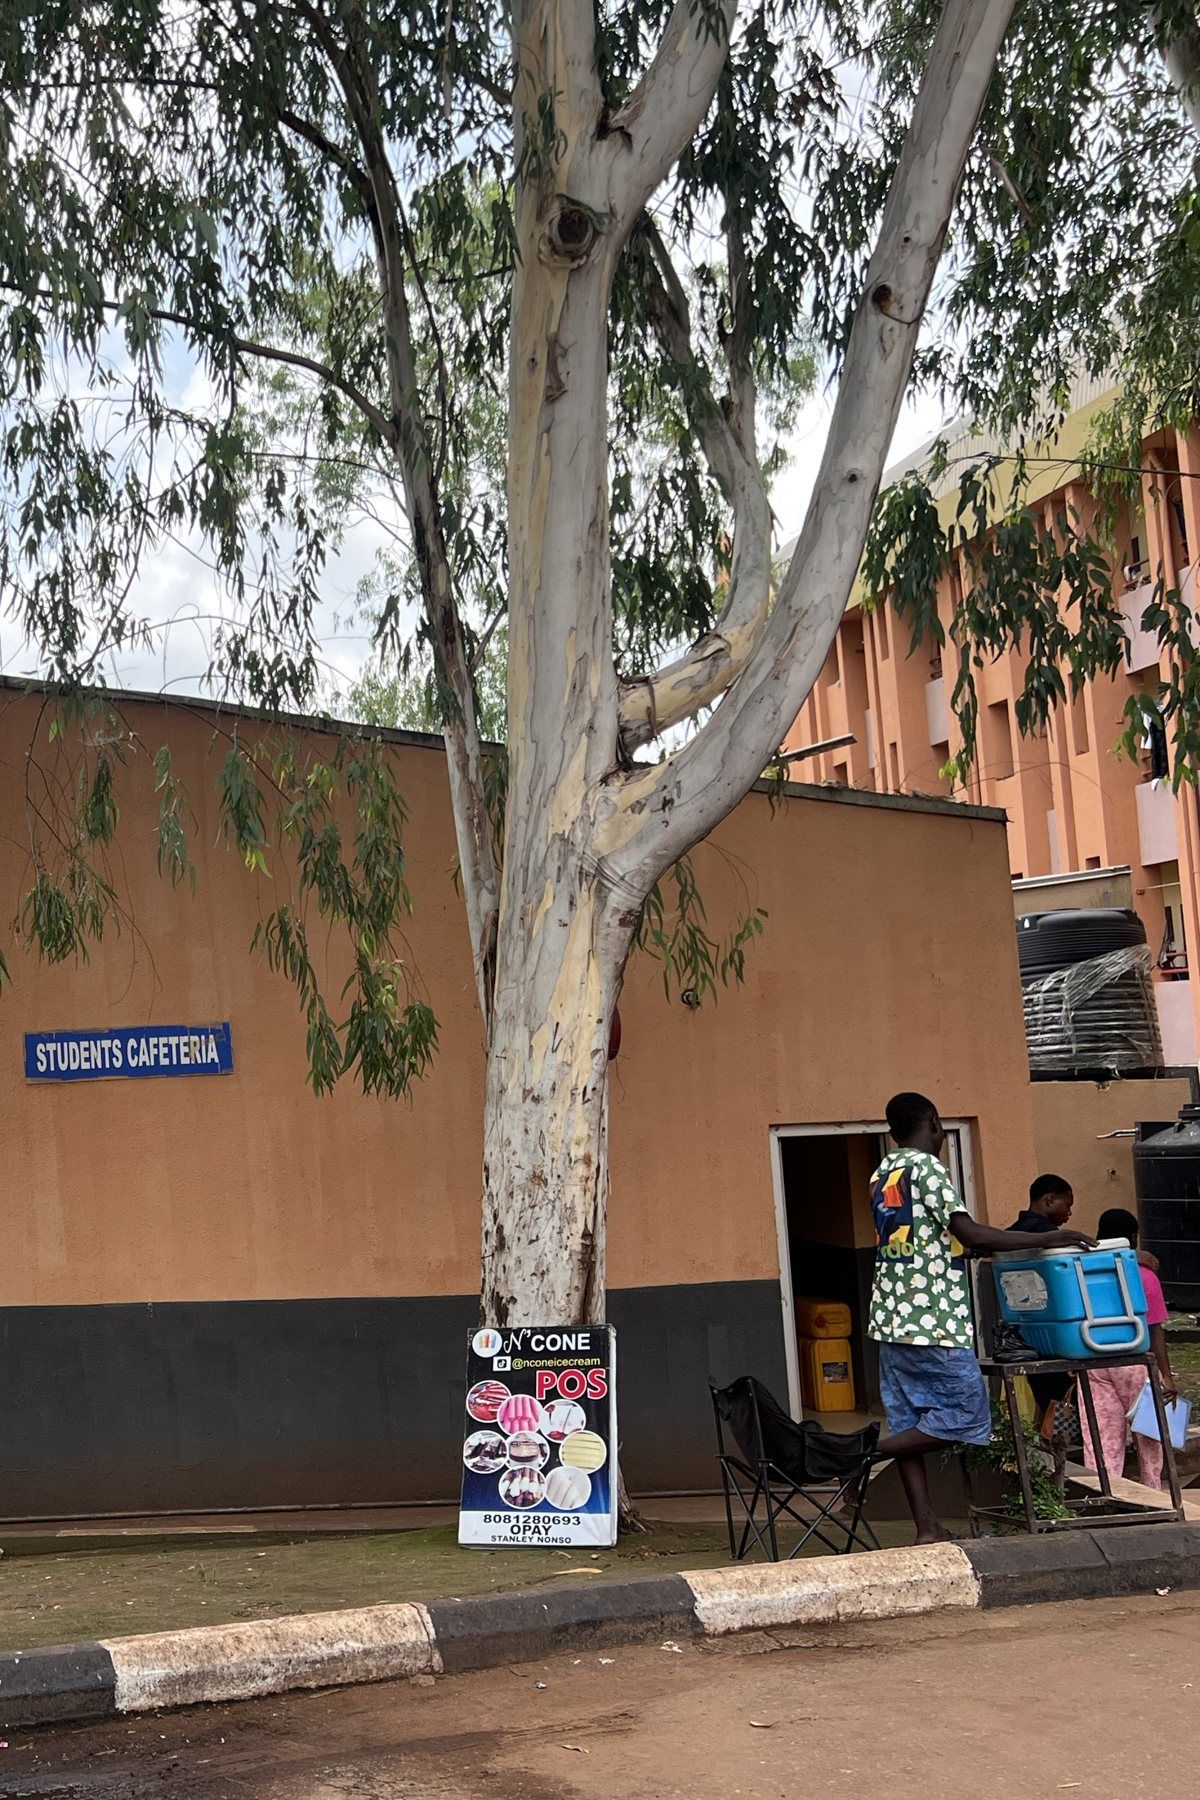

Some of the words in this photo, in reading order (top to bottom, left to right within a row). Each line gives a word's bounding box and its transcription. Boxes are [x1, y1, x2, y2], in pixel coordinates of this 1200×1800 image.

[36, 1038, 123, 1072] STUDENTS
[126, 1035, 220, 1067] CAFETERIA
[512, 1356, 601, 1370] @nconeicecream
[535, 1368, 608, 1400] POS
[483, 1514, 581, 1526] 8081280693
[510, 1524, 553, 1536] OPAY
[491, 1535, 534, 1543] STANLEY
[537, 1536, 572, 1544] NONSO
